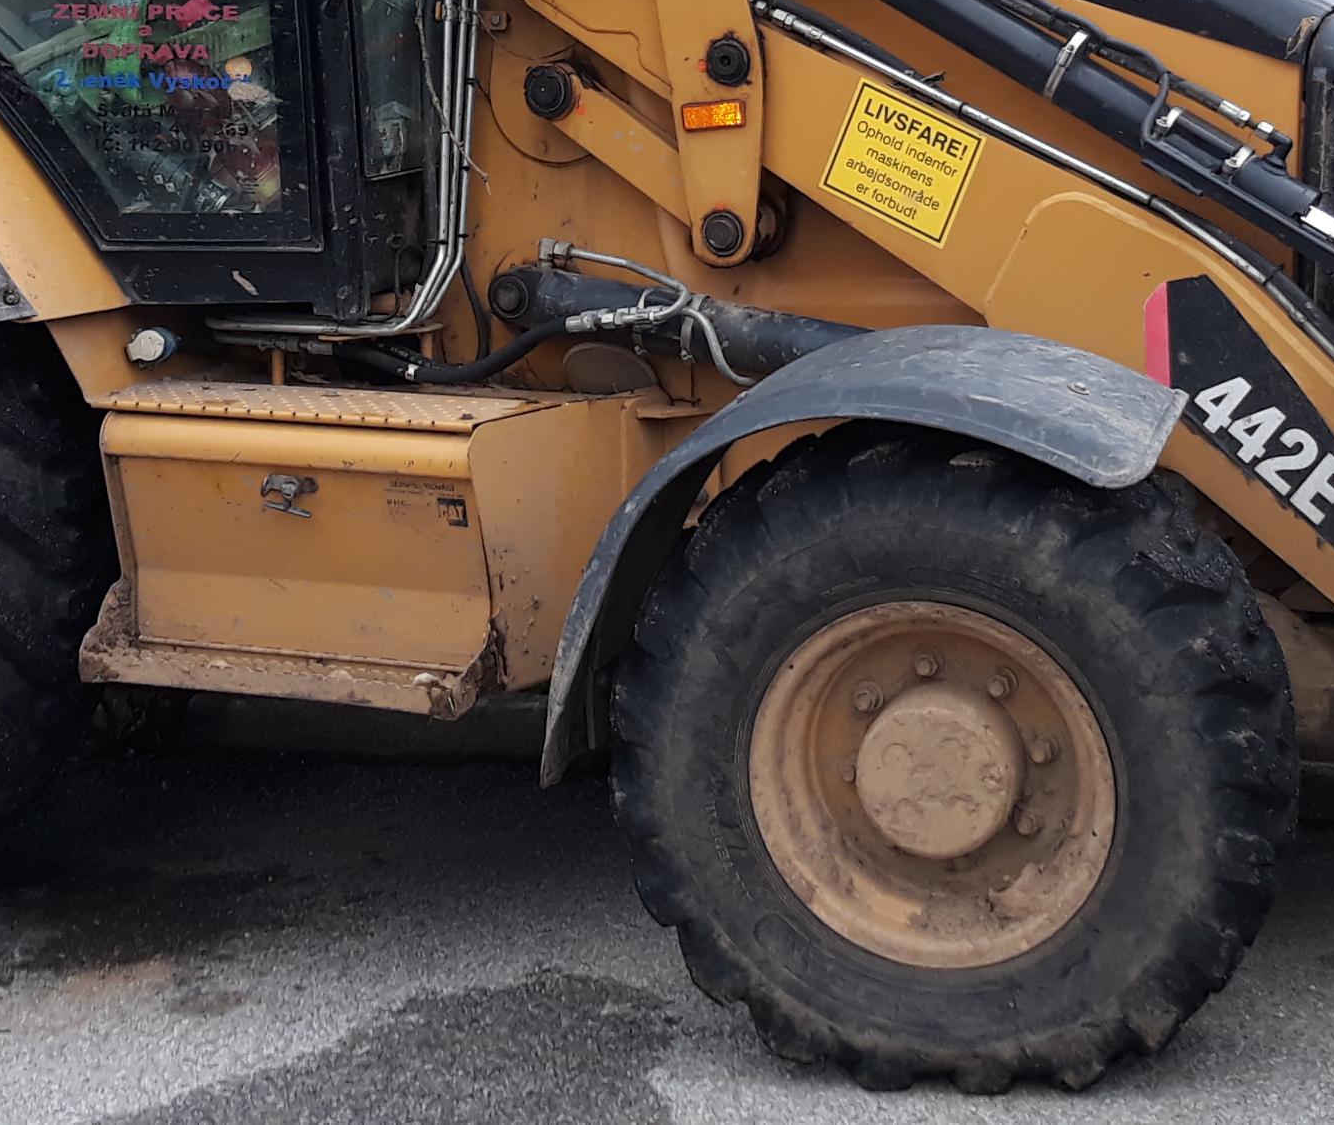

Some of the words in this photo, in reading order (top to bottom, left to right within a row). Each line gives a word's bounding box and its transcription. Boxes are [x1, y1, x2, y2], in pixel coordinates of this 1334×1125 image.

[138, 25, 153, 37] a
[147, 3, 240, 21] PRCE
[82, 43, 210, 61] DOPRAVA
[857, 120, 903, 151] Ophold
[904, 142, 958, 178] indenfor
[863, 98, 969, 161] LIVSFARE!
[845, 157, 940, 211] arbejdsområde
[865, 146, 934, 187] maskinens
[855, 182, 871, 194] er
[871, 186, 918, 220] forbudt
